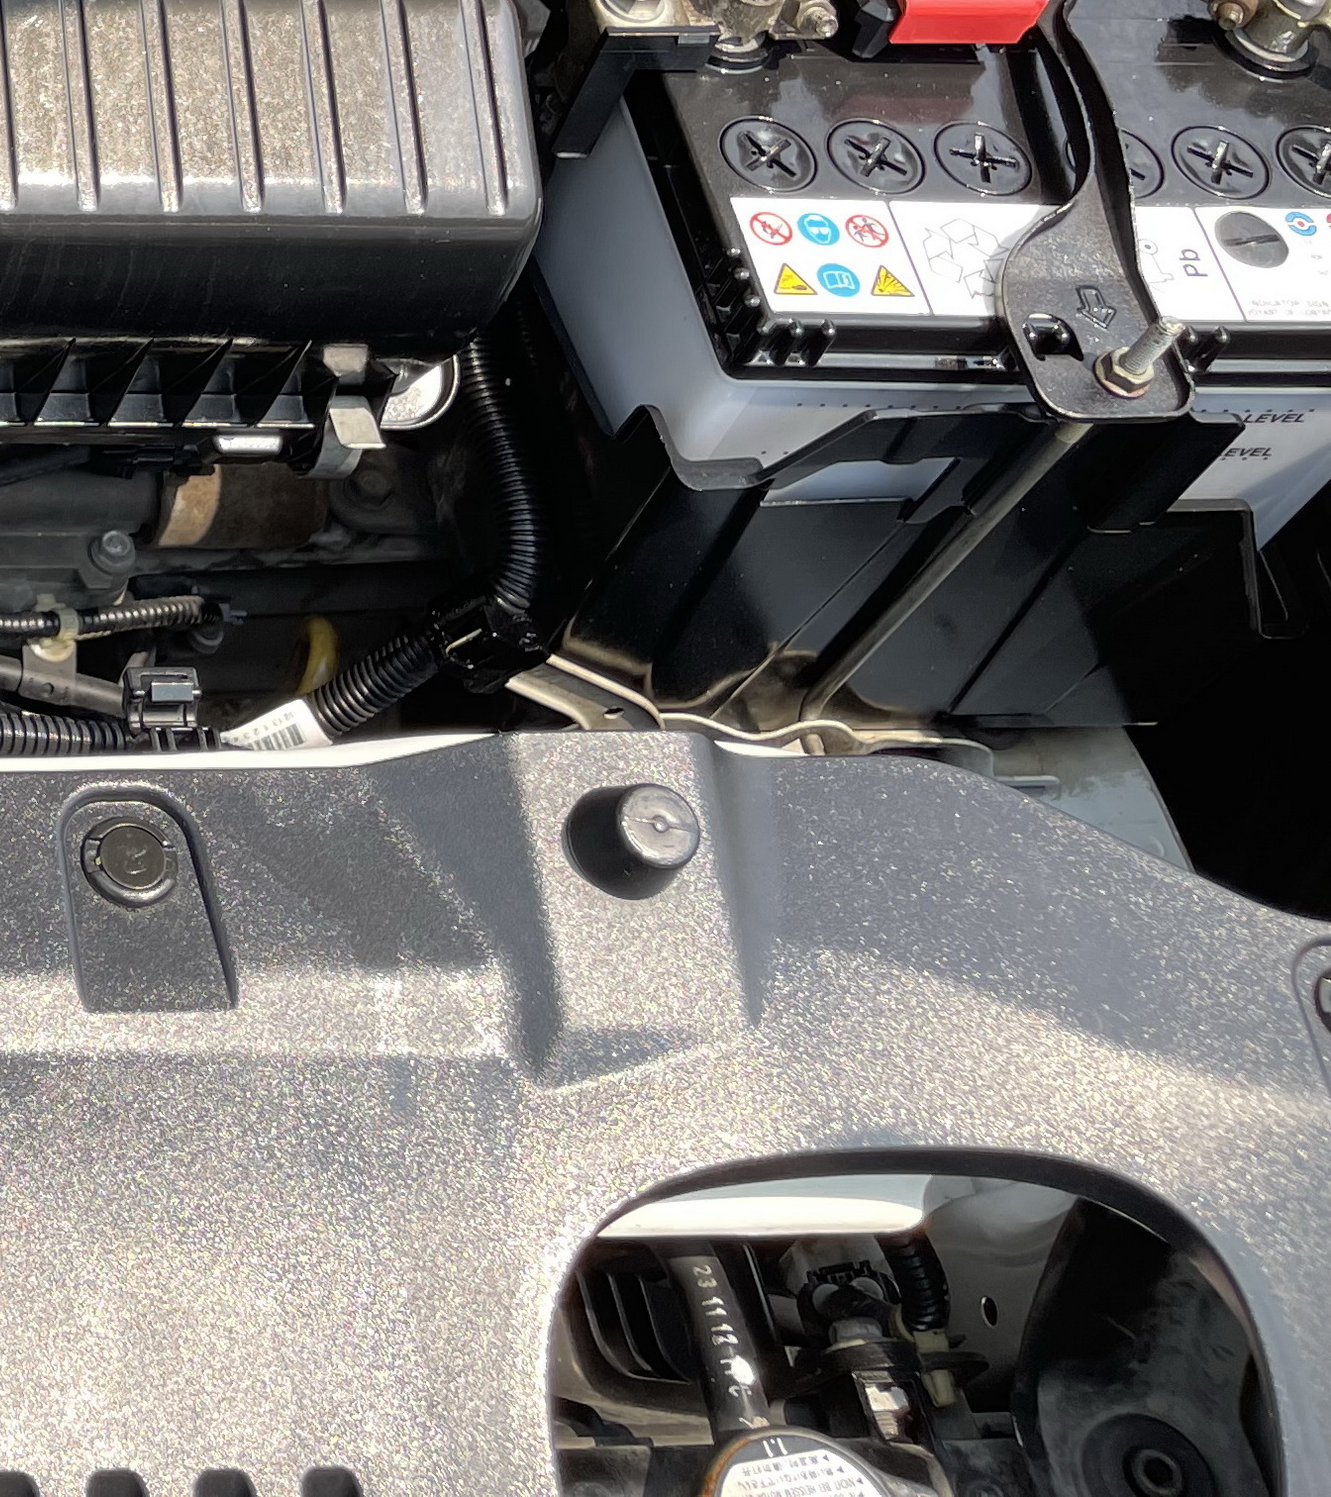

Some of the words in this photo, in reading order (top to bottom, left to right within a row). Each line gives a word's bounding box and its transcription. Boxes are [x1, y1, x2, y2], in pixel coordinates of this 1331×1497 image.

[1176, 248, 1209, 277] Pb
[1242, 413, 1305, 424] LEVEL
[1220, 447, 1273, 458] EVEL
[693, 1264, 718, 1288] 23
[762, 1437, 789, 1458] 1.1
